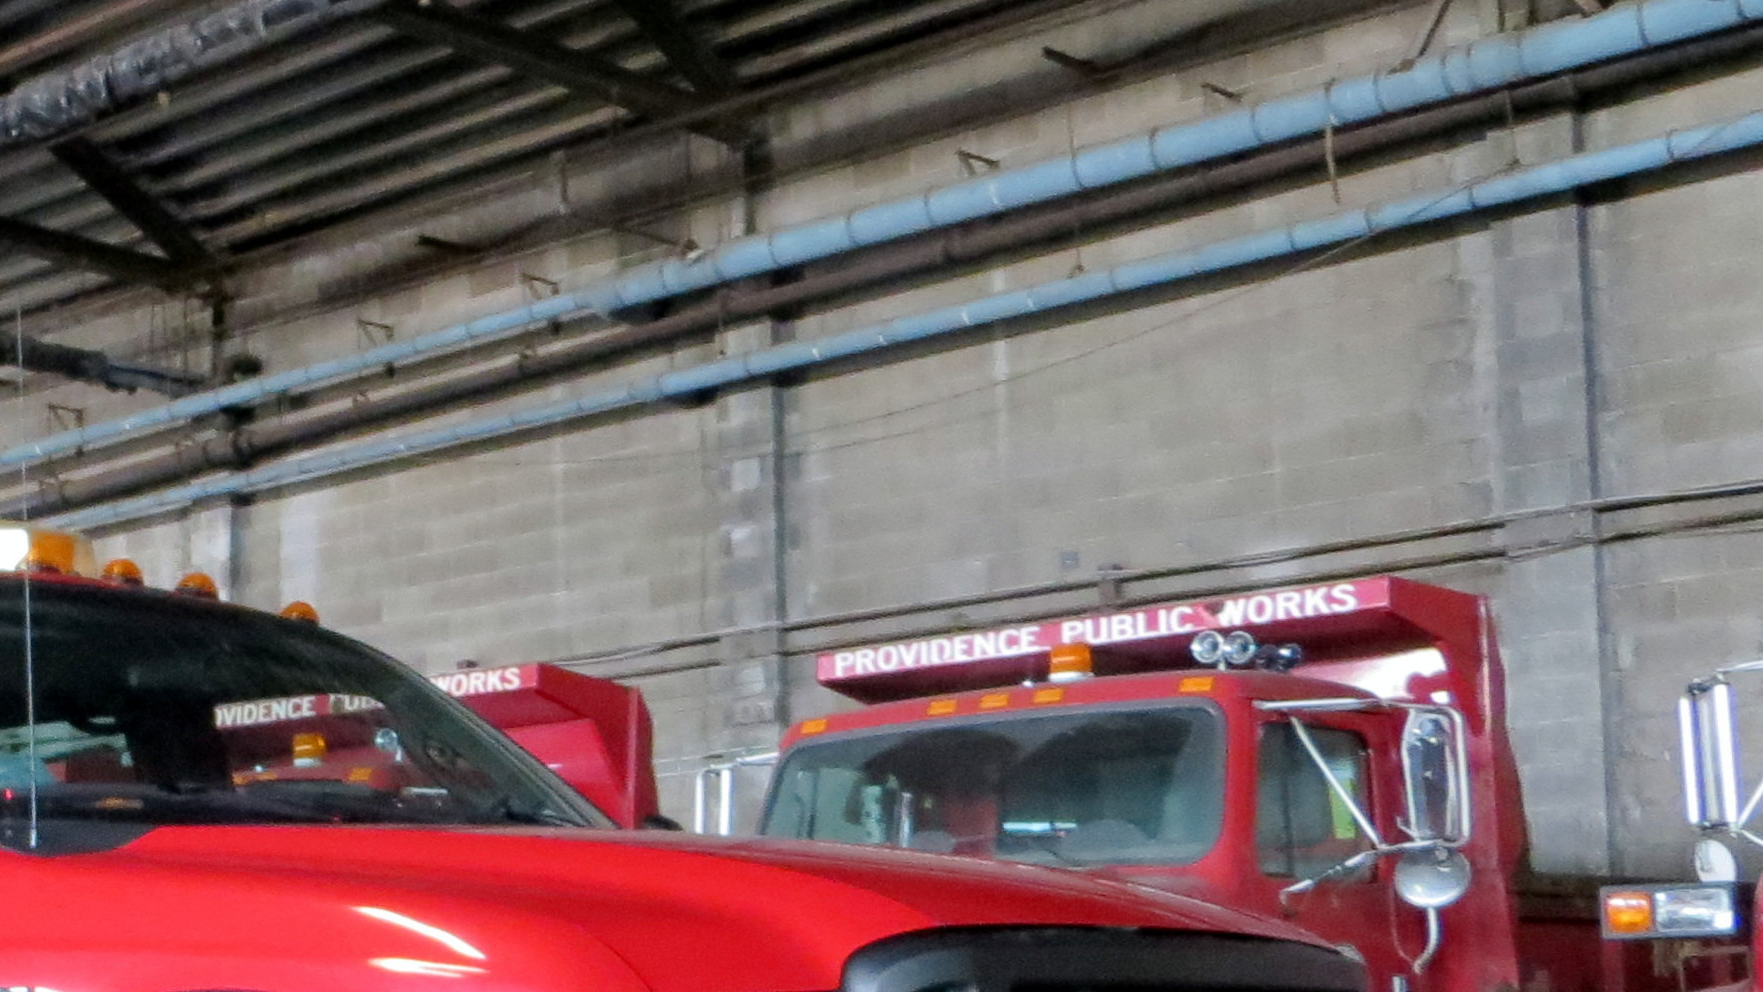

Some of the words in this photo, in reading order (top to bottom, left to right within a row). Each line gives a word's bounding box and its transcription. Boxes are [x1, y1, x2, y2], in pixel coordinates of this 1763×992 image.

[835, 626, 1042, 678] PROVIDENCE
[1061, 605, 1194, 644] PUBLIC
[1217, 583, 1358, 627] WORKS
